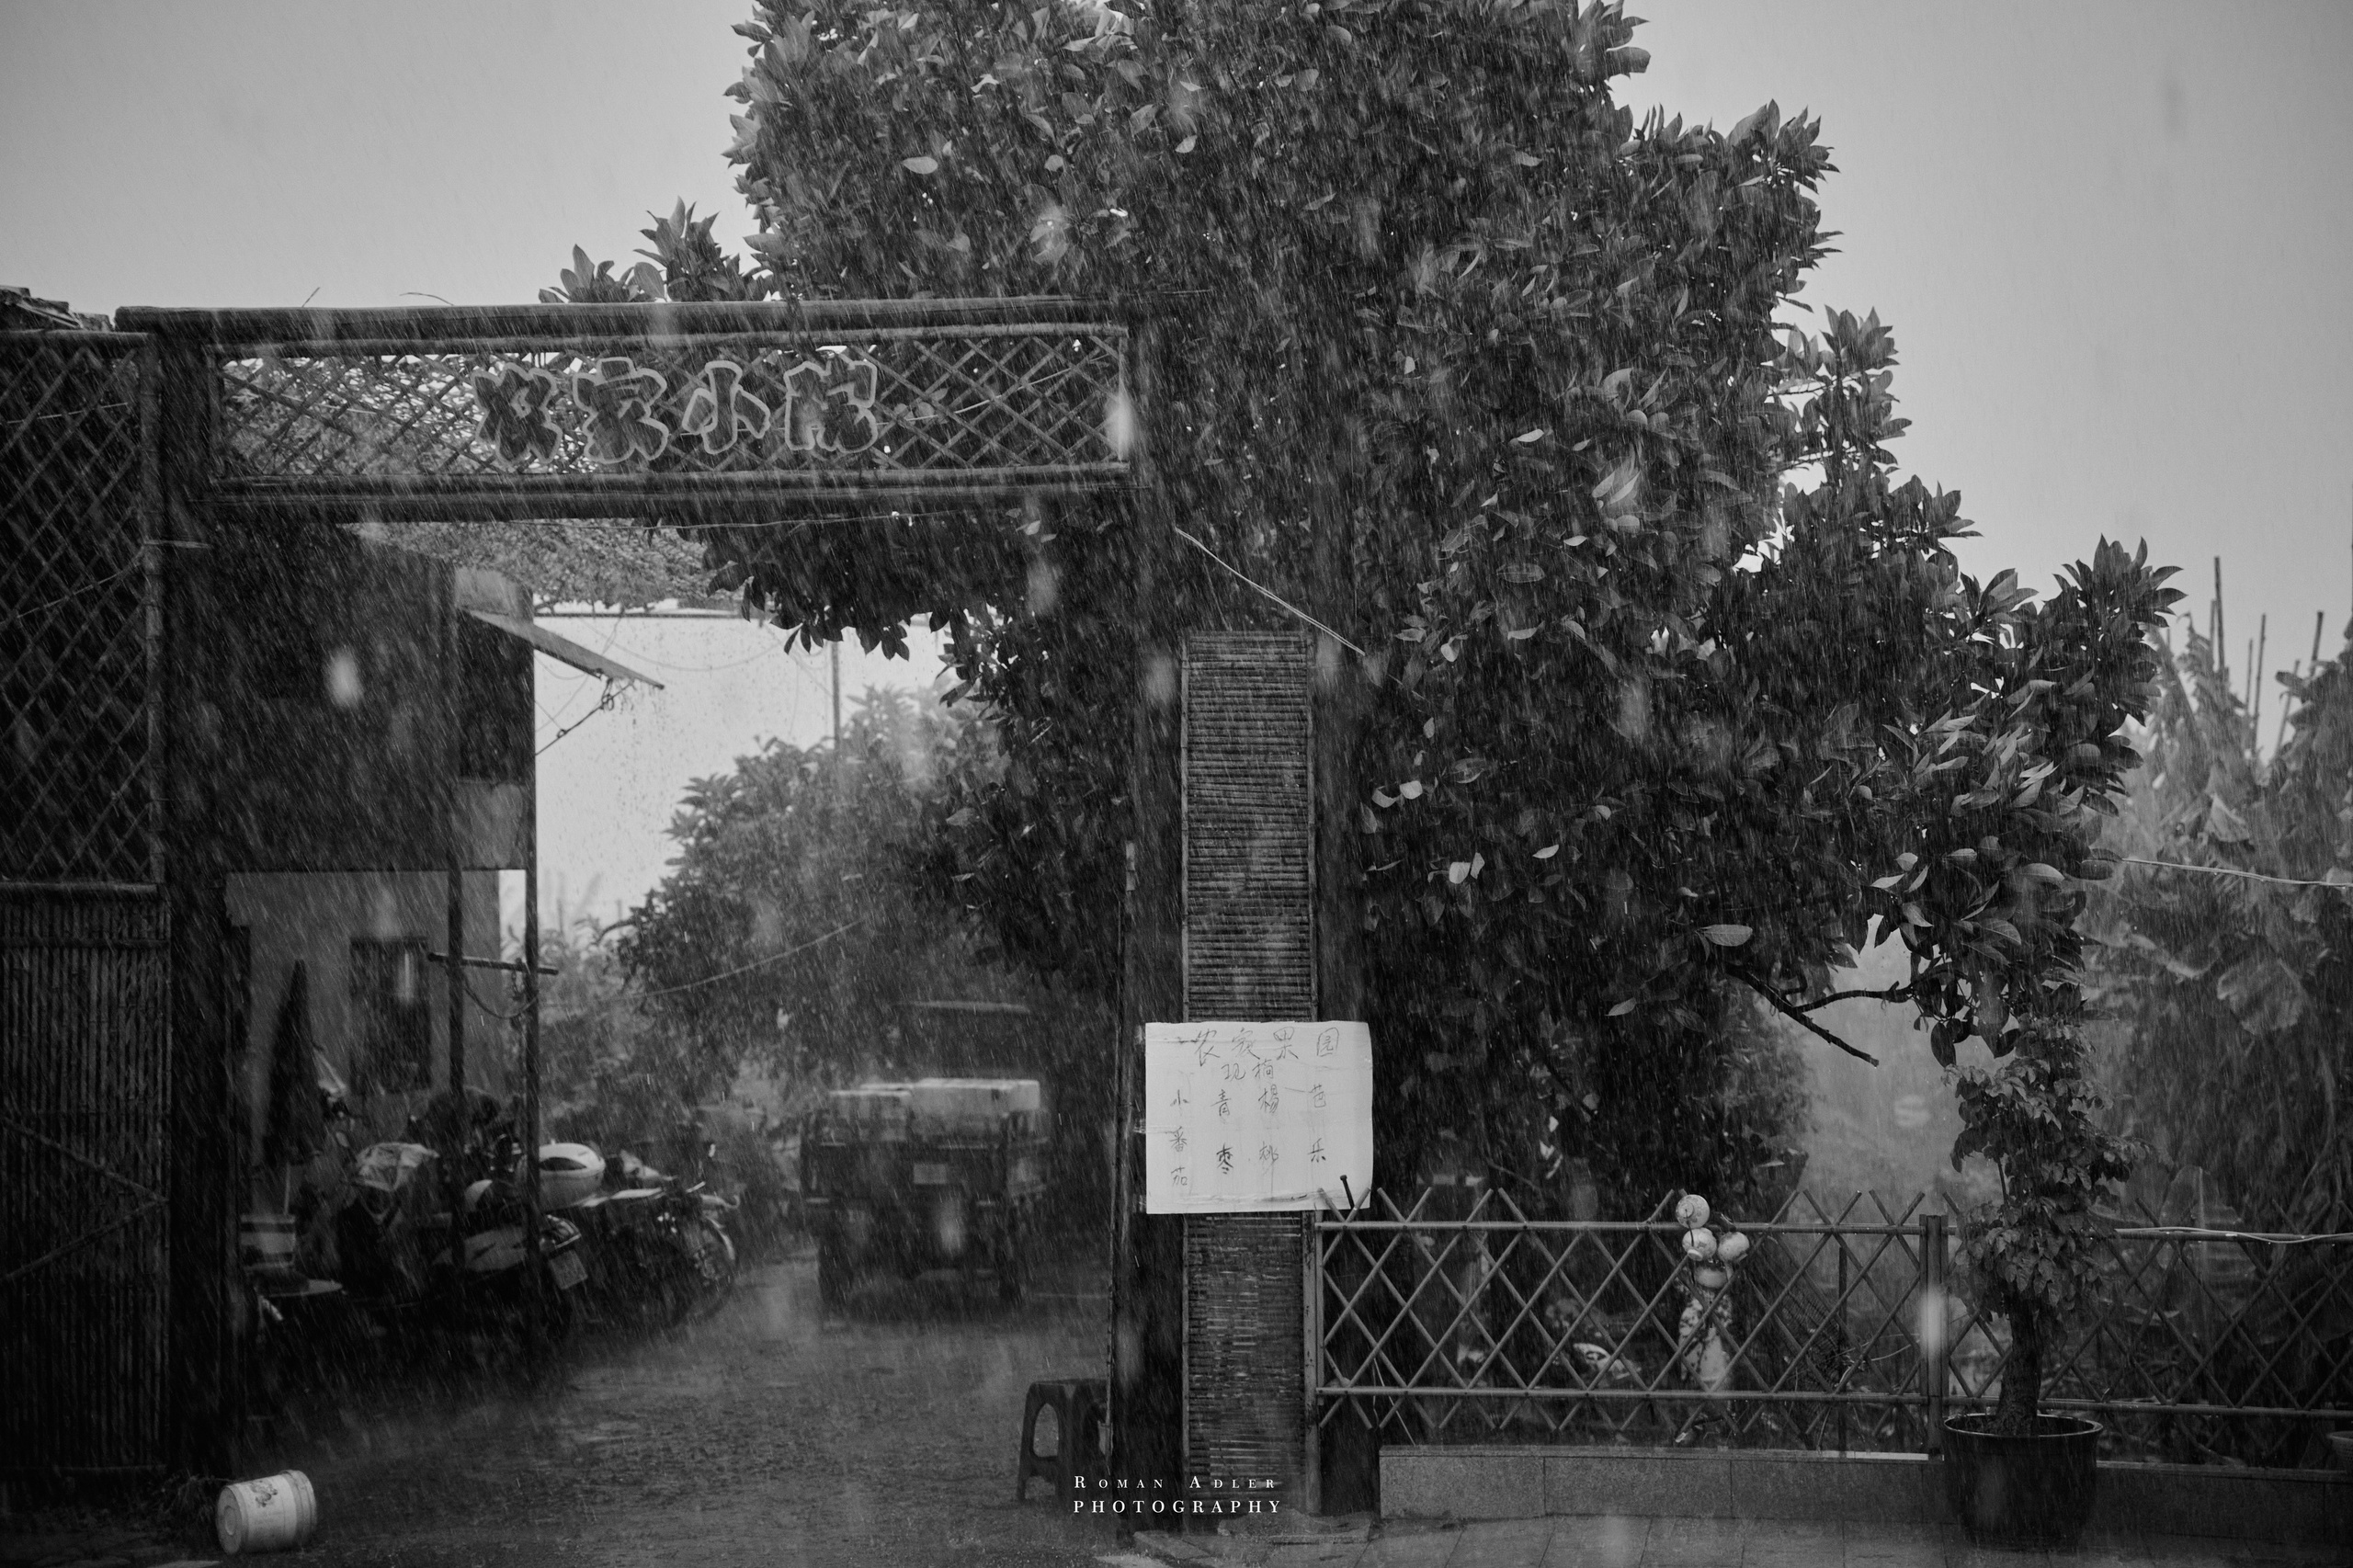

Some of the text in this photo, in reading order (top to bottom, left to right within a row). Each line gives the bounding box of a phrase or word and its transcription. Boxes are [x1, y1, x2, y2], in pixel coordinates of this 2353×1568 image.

[1194, 1027, 1340, 1067] 农家果园
[1170, 1088, 1189, 1187] 小番茄
[1211, 1088, 1234, 1176] 青枣
[1308, 1084, 1326, 1164] 芭乐
